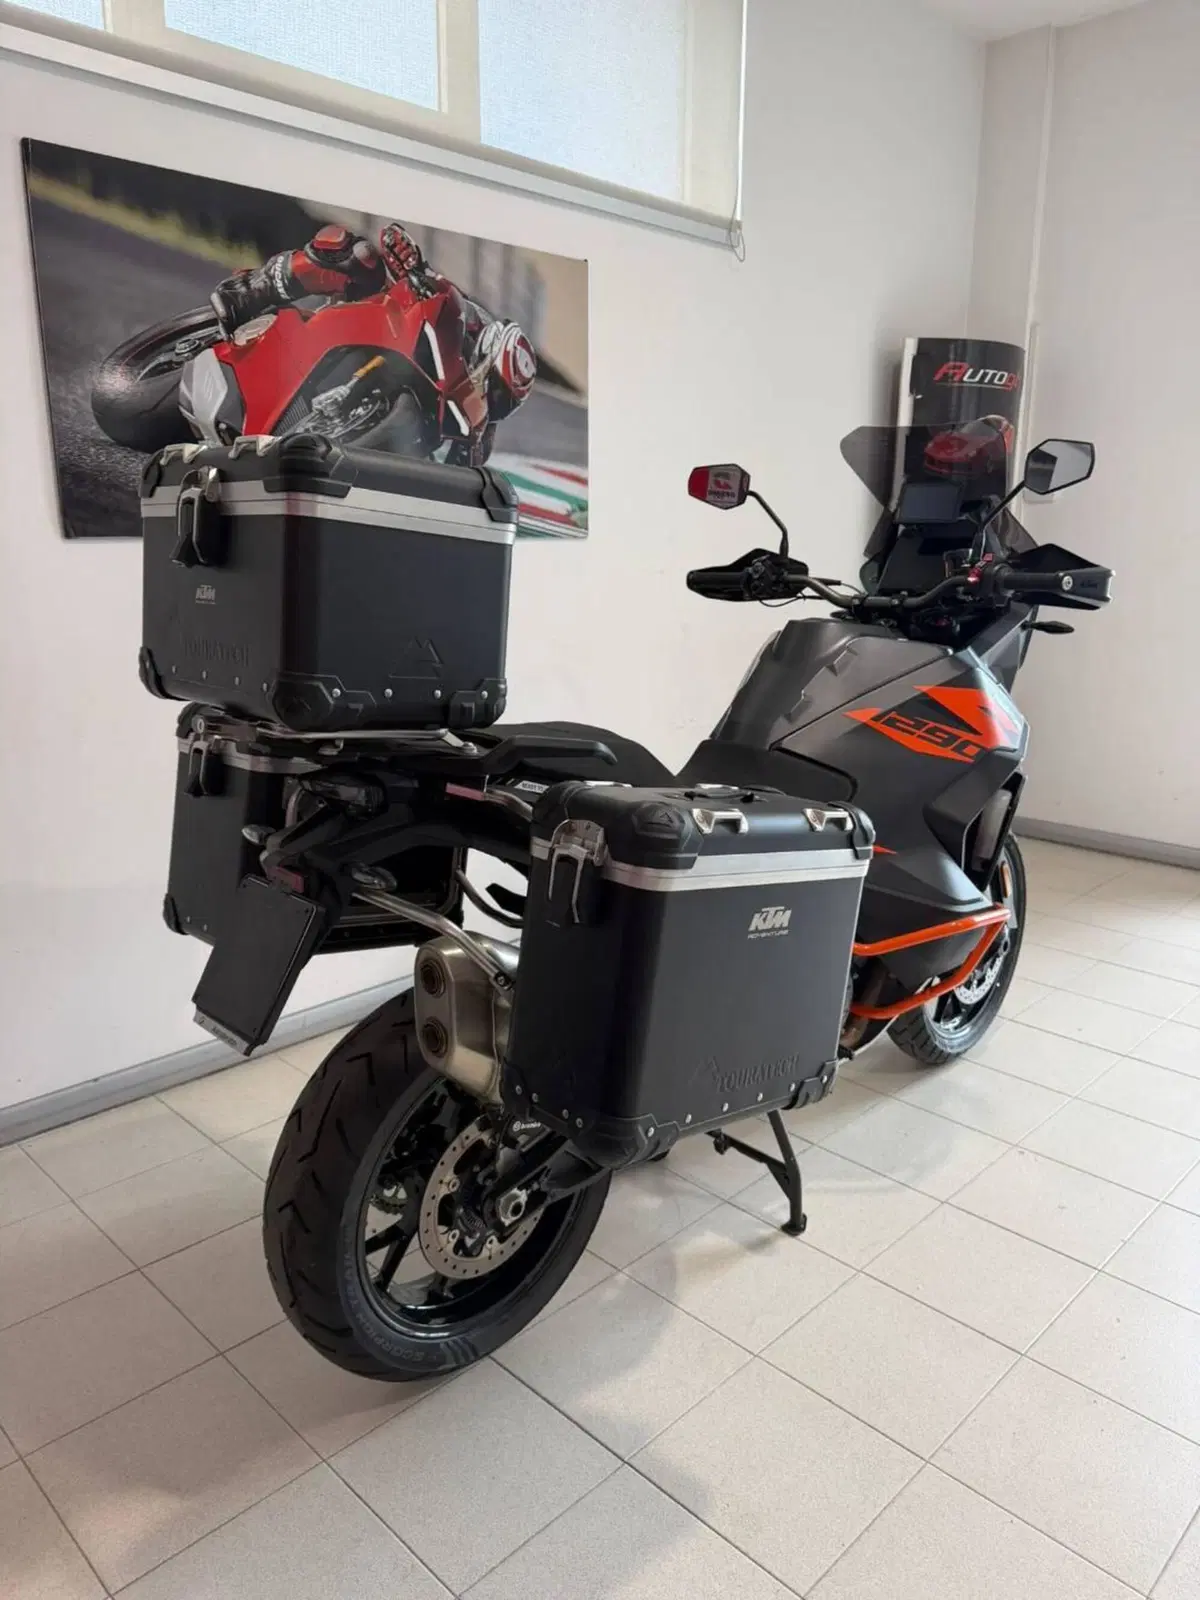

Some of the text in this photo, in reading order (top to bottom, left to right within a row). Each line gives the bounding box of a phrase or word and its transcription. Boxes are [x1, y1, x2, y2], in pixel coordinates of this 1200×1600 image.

[870, 708, 984, 759] 1290
[748, 906, 792, 931] KTM
[714, 1053, 799, 1093] TOURATECH
